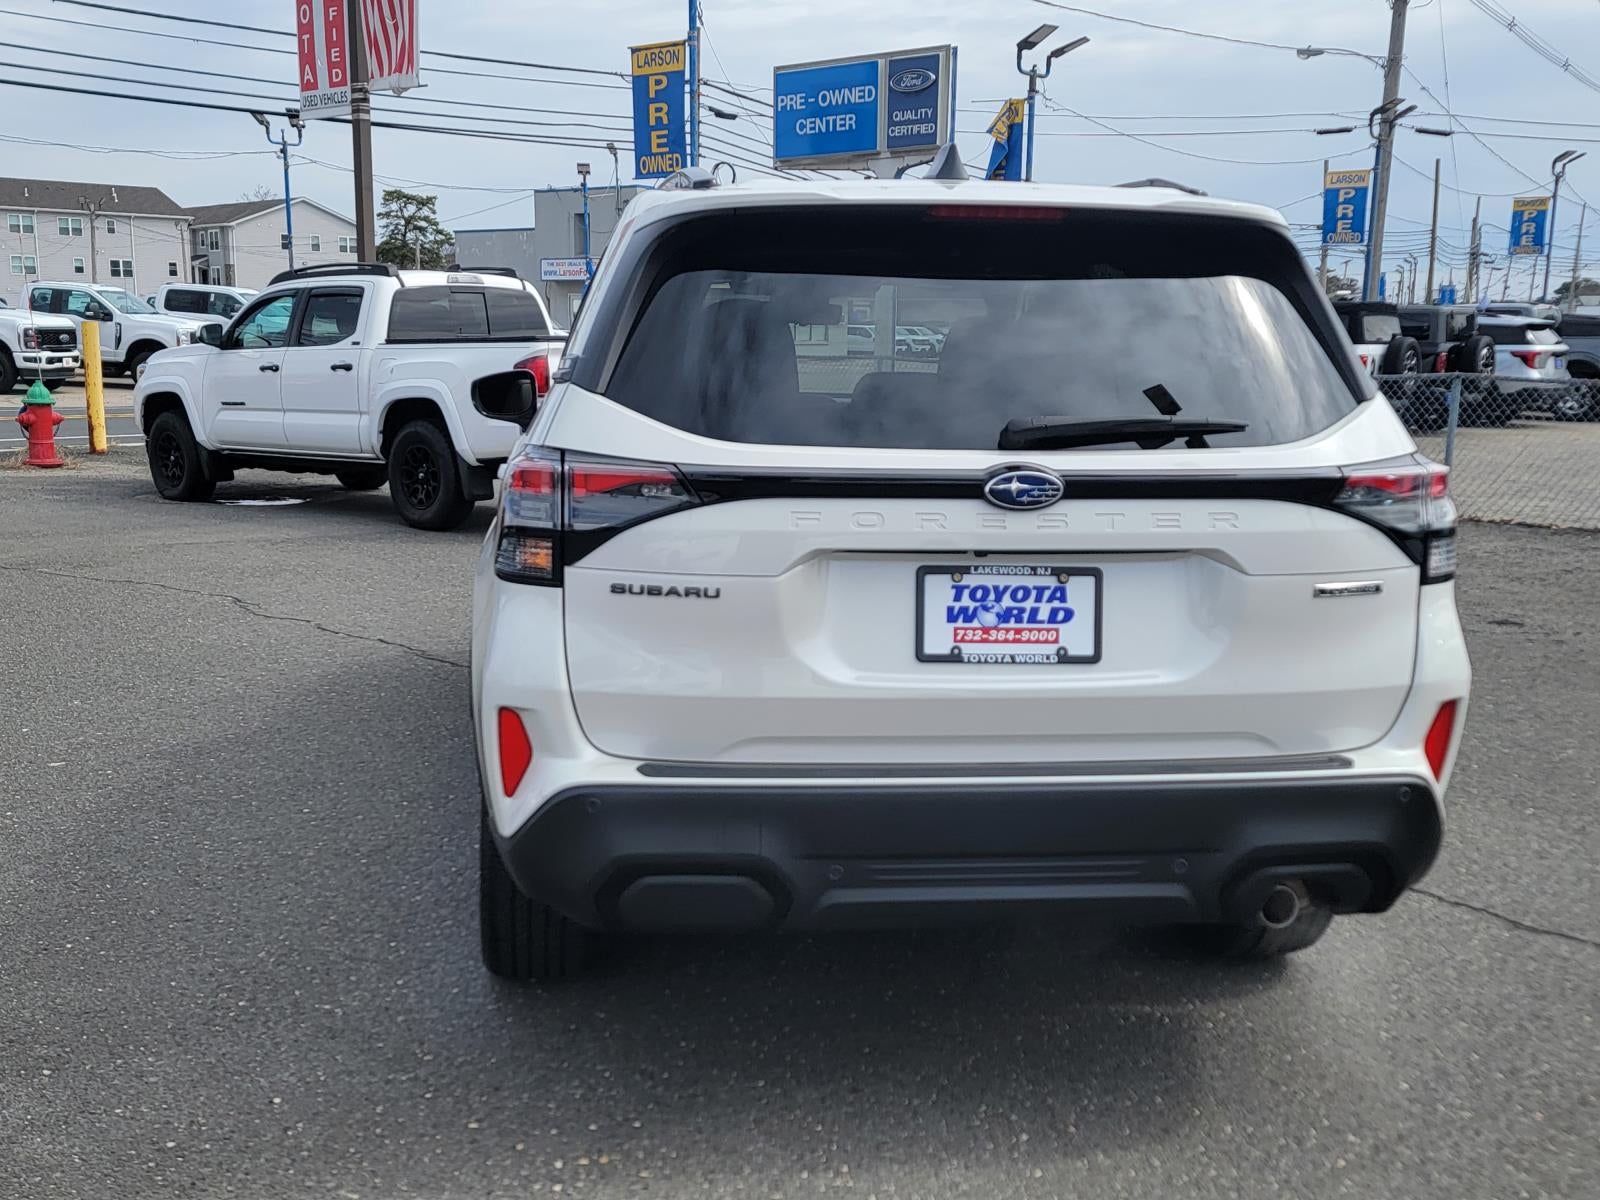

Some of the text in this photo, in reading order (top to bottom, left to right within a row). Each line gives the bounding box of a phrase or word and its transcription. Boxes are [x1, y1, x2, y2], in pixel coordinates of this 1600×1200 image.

[636, 49, 680, 69] LARSON
[900, 73, 923, 87] Ford
[303, 91, 348, 108] USED VEHICLES
[648, 75, 669, 153] PRE
[892, 107, 933, 122] QUALITY
[795, 114, 856, 135] CENTER
[888, 123, 935, 137] CERTIFIED
[640, 153, 682, 174] OWNED
[1330, 174, 1366, 184] LARSON
[1337, 188, 1356, 232] PRE
[1327, 232, 1361, 243] OWNED
[790, 511, 1240, 531] FORESTER
[1037, 567, 1052, 576] NJ
[610, 583, 720, 599] SUBARU
[951, 584, 1068, 603] TOYOTA
[956, 629, 1057, 641] 732-364-9000
[962, 654, 1059, 663] TOYOTA WORLD
